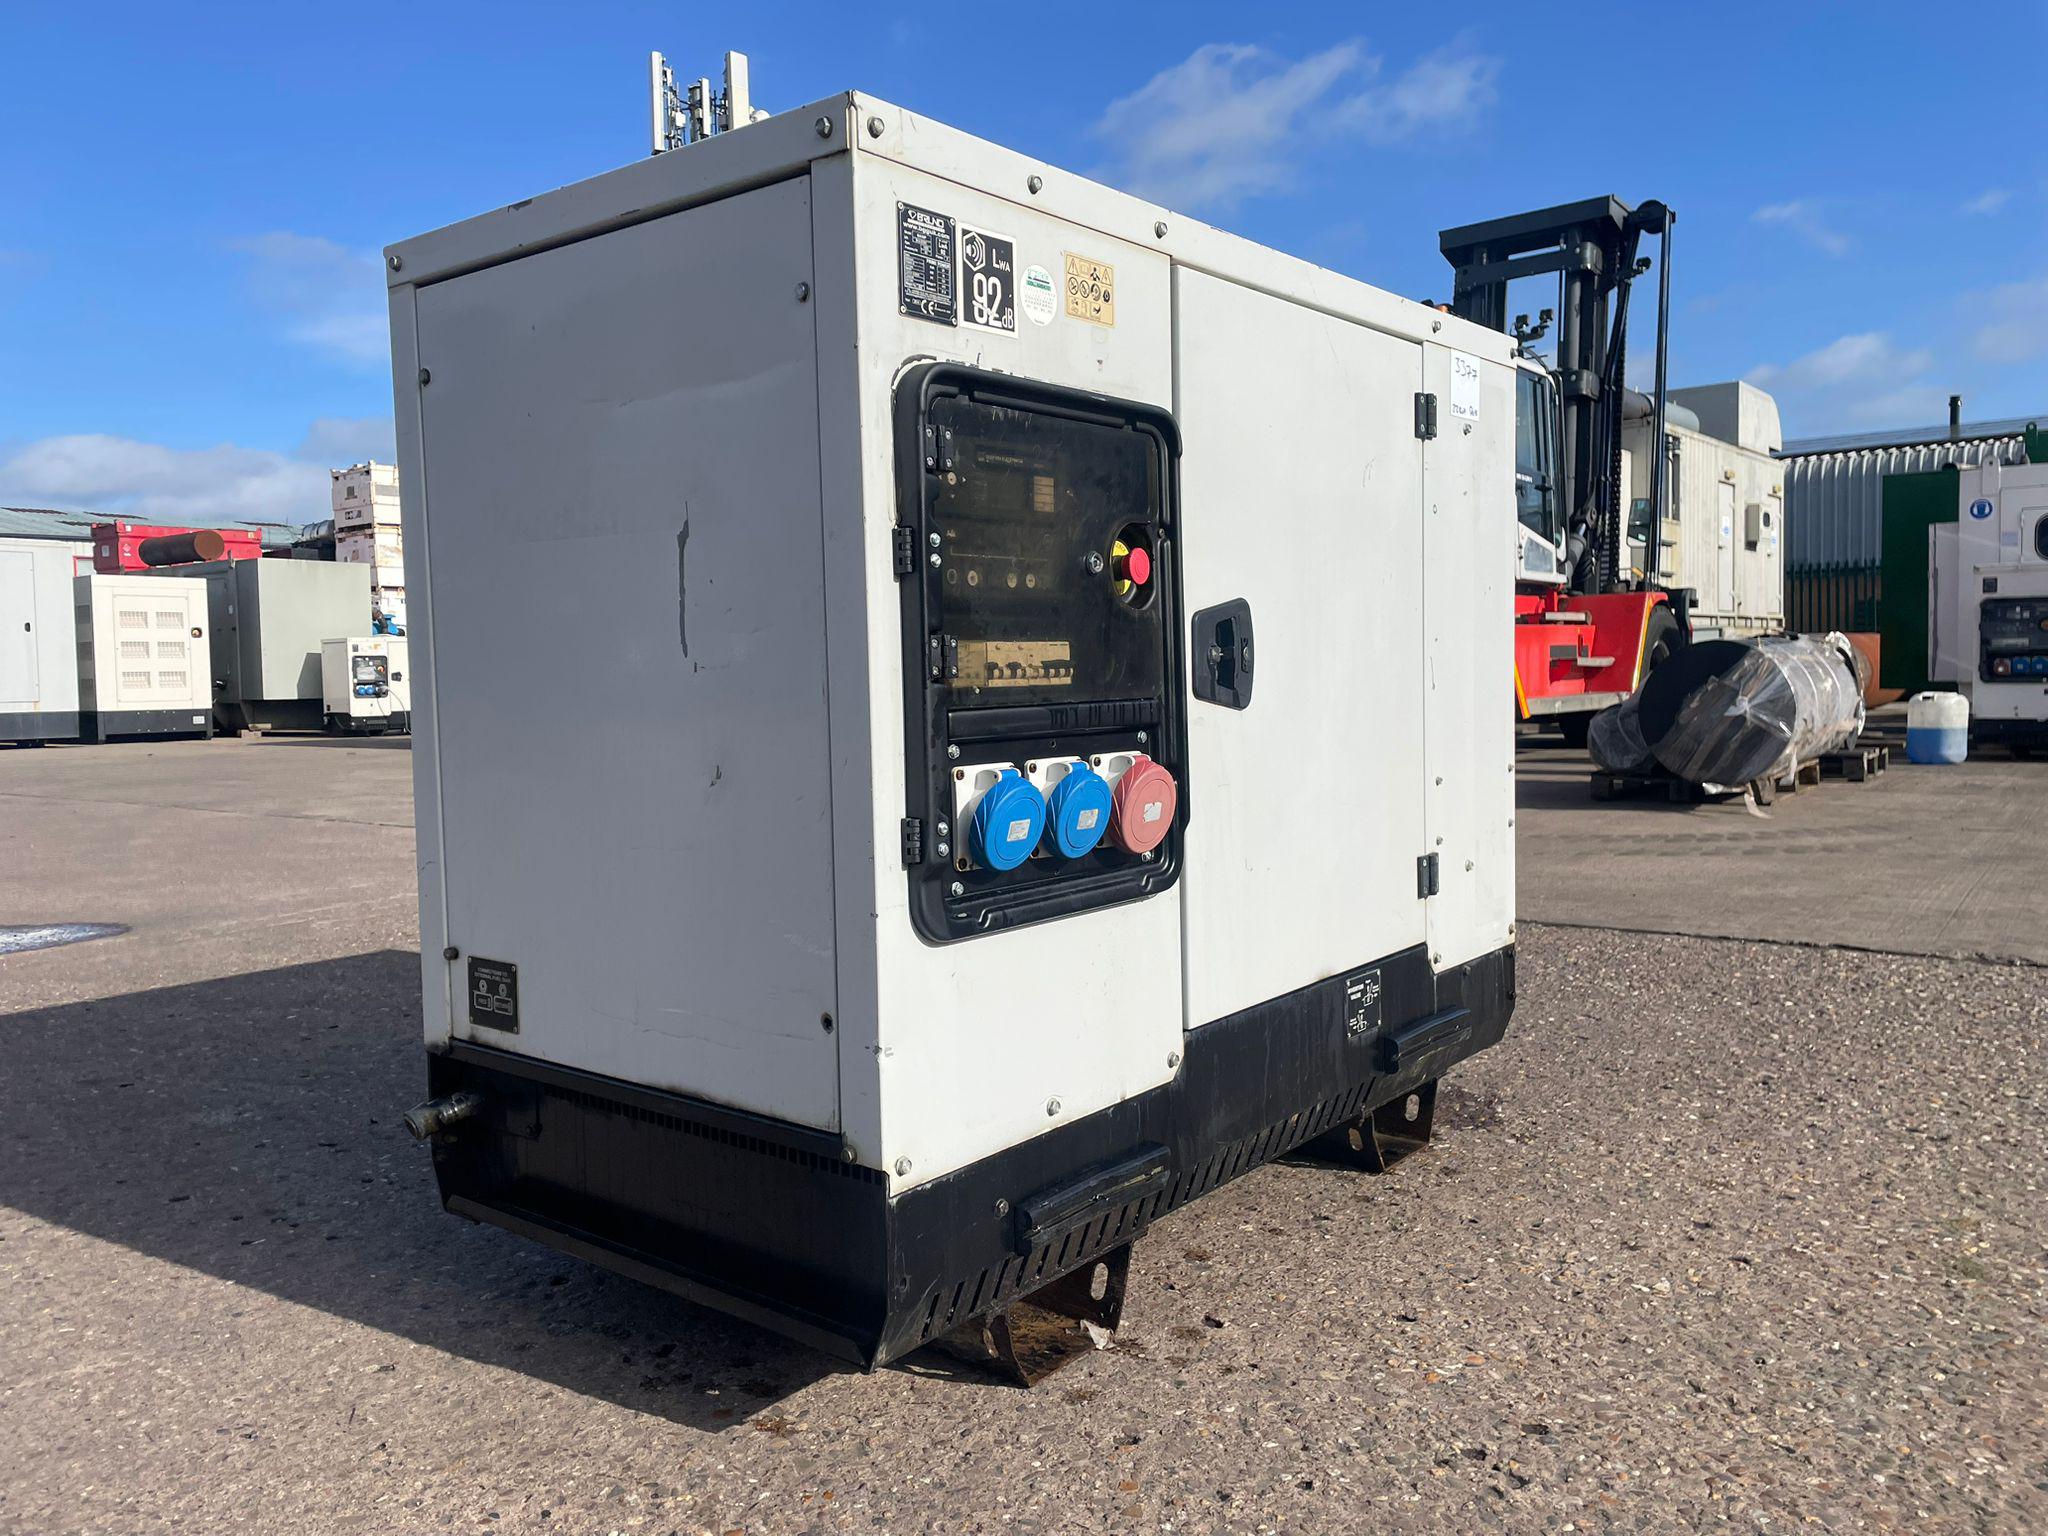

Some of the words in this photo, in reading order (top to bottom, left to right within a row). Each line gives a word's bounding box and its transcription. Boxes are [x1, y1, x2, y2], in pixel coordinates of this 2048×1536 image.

[917, 212, 944, 229] BRUNO
[972, 272, 1003, 327] 92
[1002, 307, 1014, 330] dB
[1455, 357, 1478, 382] 3377
